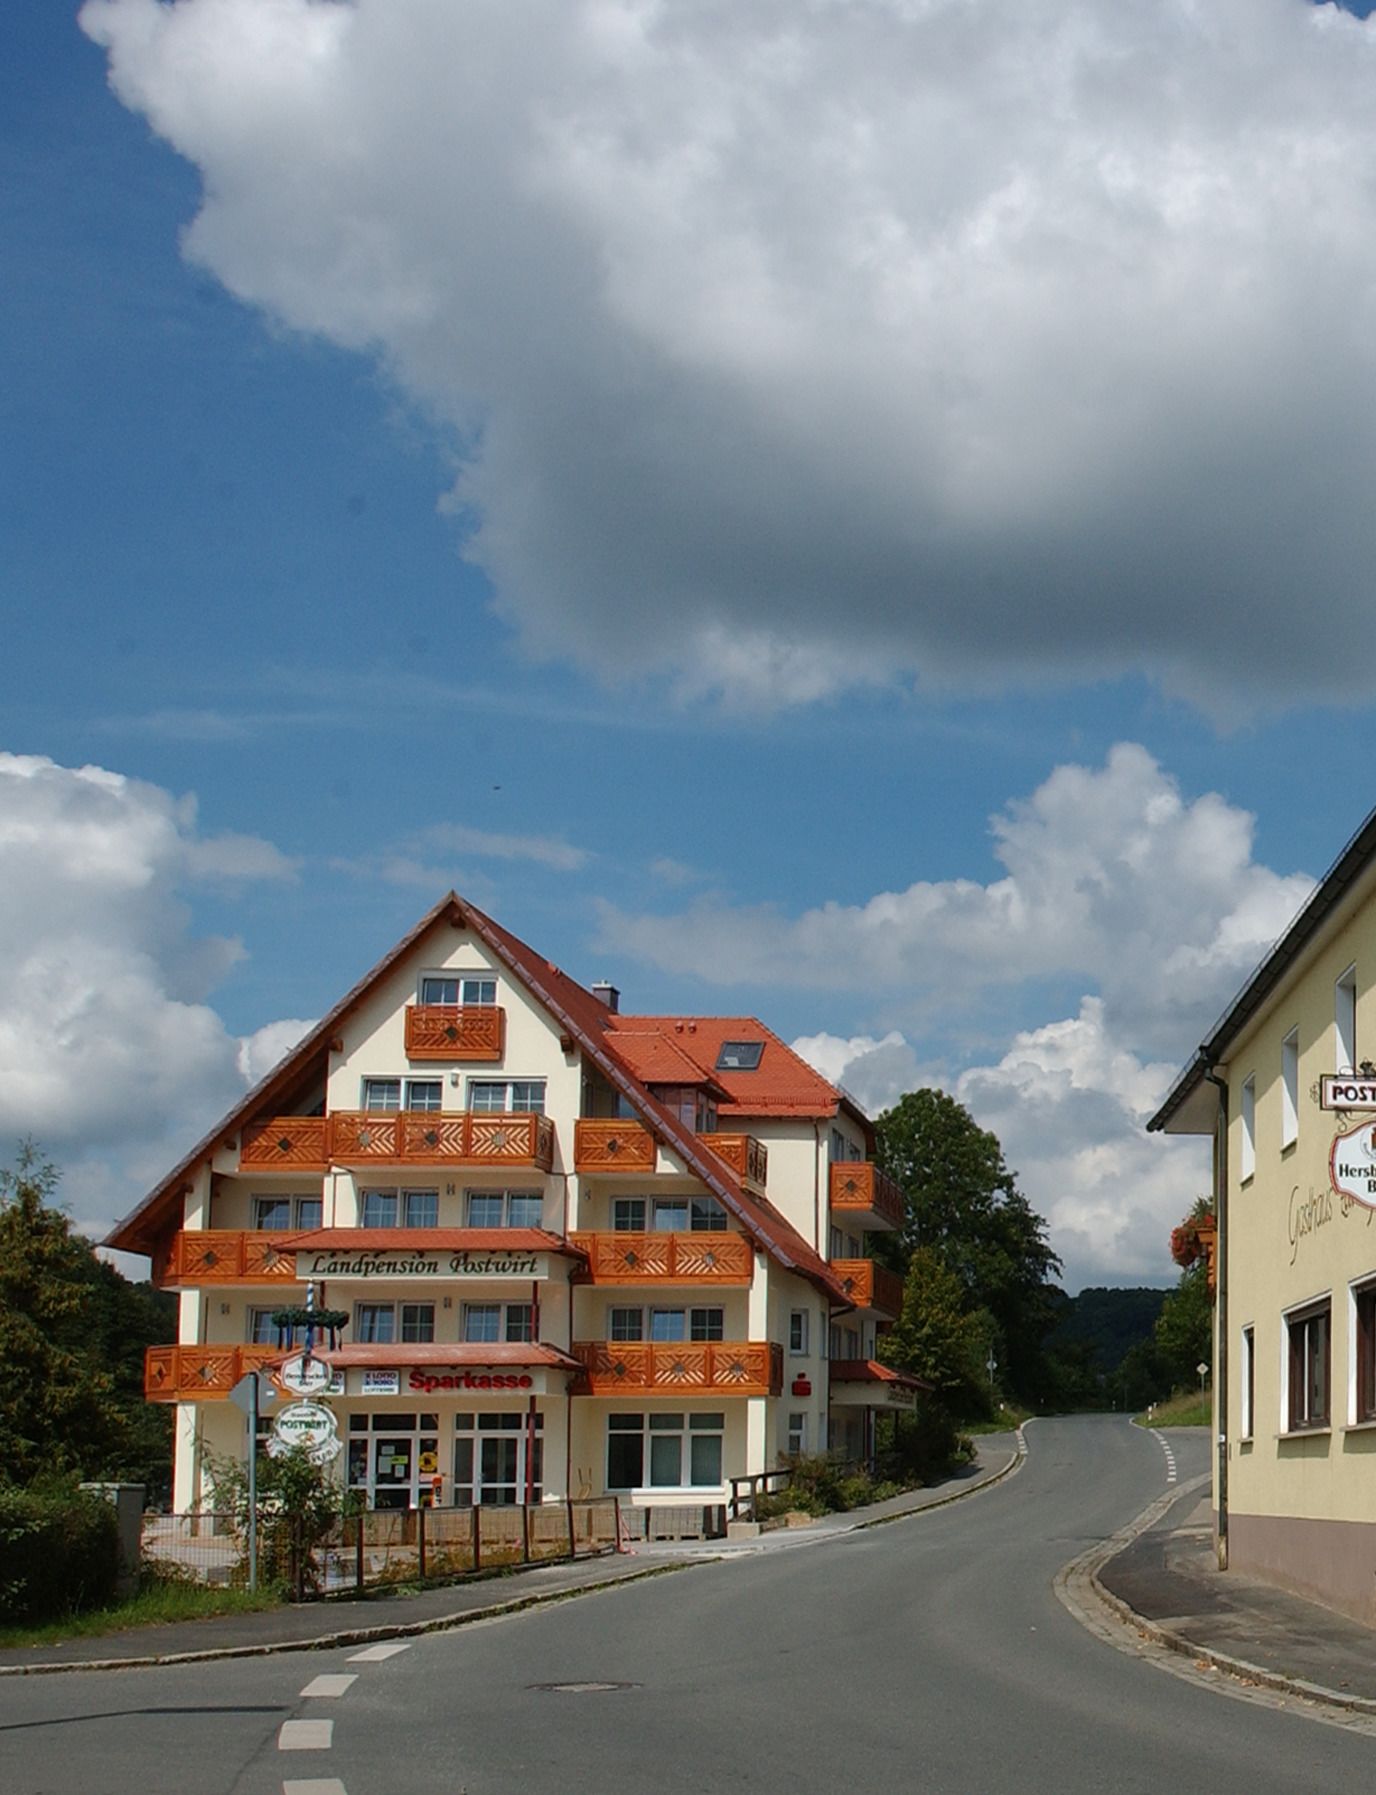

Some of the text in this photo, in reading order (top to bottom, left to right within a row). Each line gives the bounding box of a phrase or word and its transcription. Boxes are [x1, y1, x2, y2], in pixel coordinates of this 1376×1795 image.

[310, 1253, 538, 1277] Landpension Postwirt
[409, 1371, 533, 1393] Sparkasse
[281, 1420, 328, 1430] POSTWIRT
